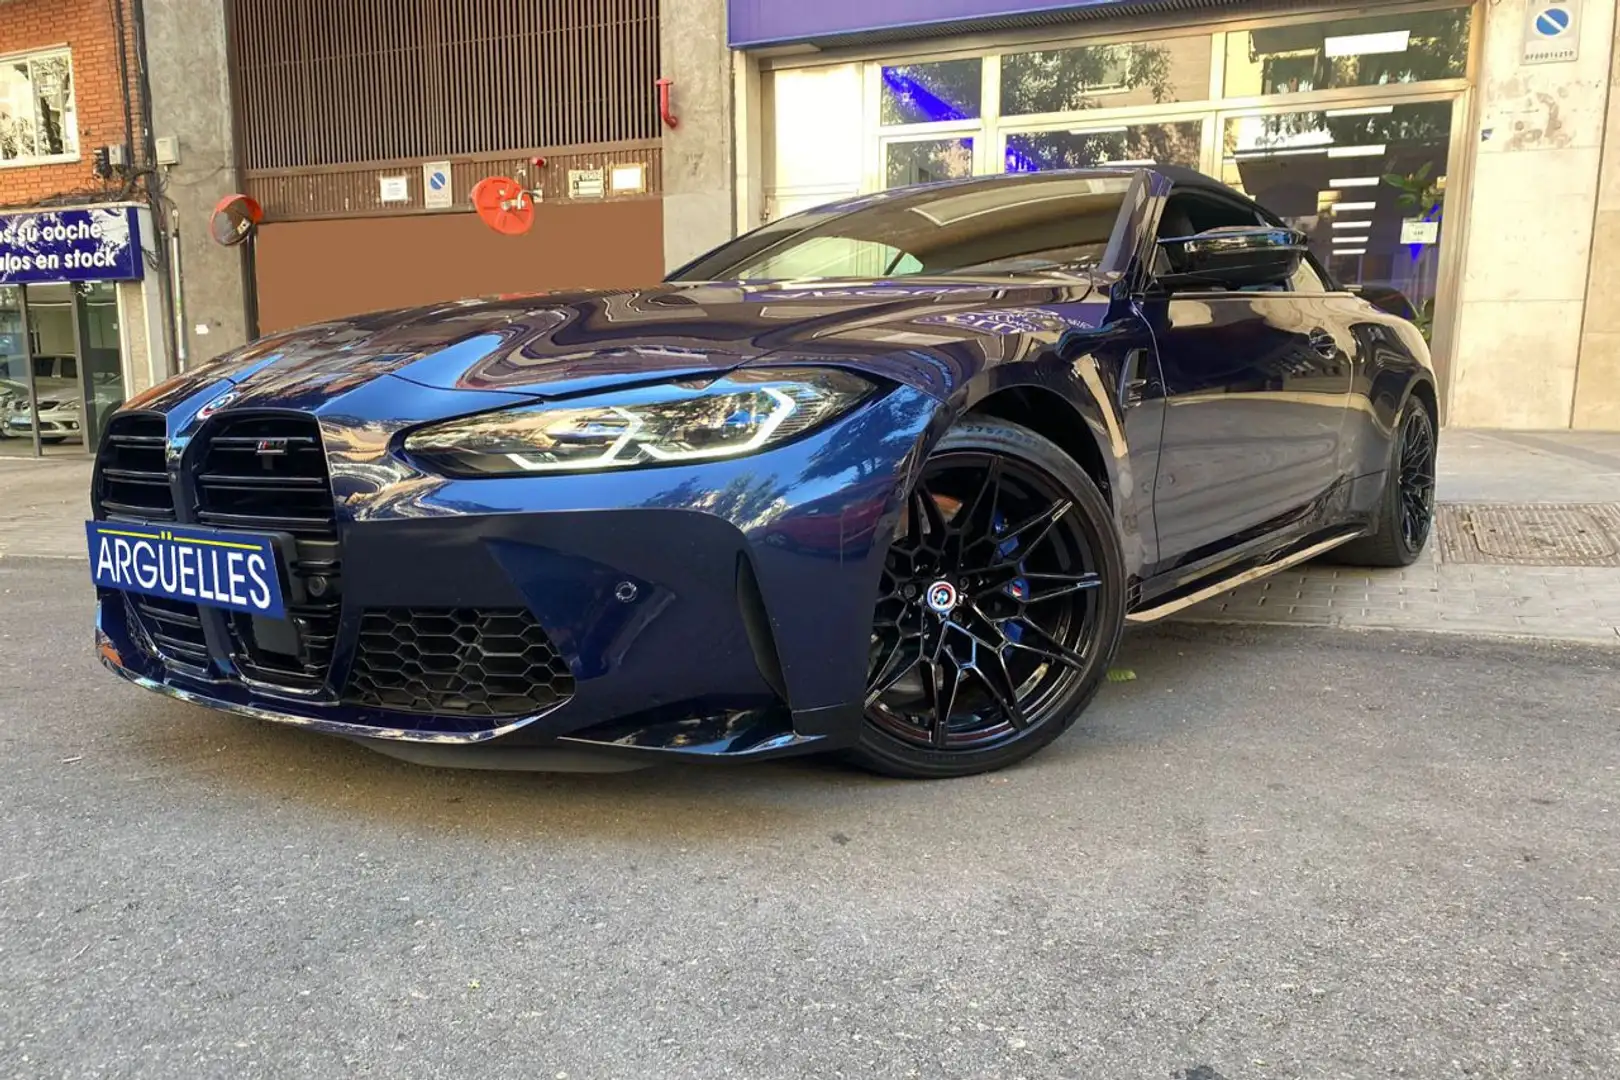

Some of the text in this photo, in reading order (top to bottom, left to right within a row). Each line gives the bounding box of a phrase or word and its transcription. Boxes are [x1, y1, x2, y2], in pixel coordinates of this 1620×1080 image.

[17, 225, 38, 243] su
[35, 253, 59, 269] en
[64, 248, 117, 268] stock
[97, 531, 271, 609] ARGÜELLES
